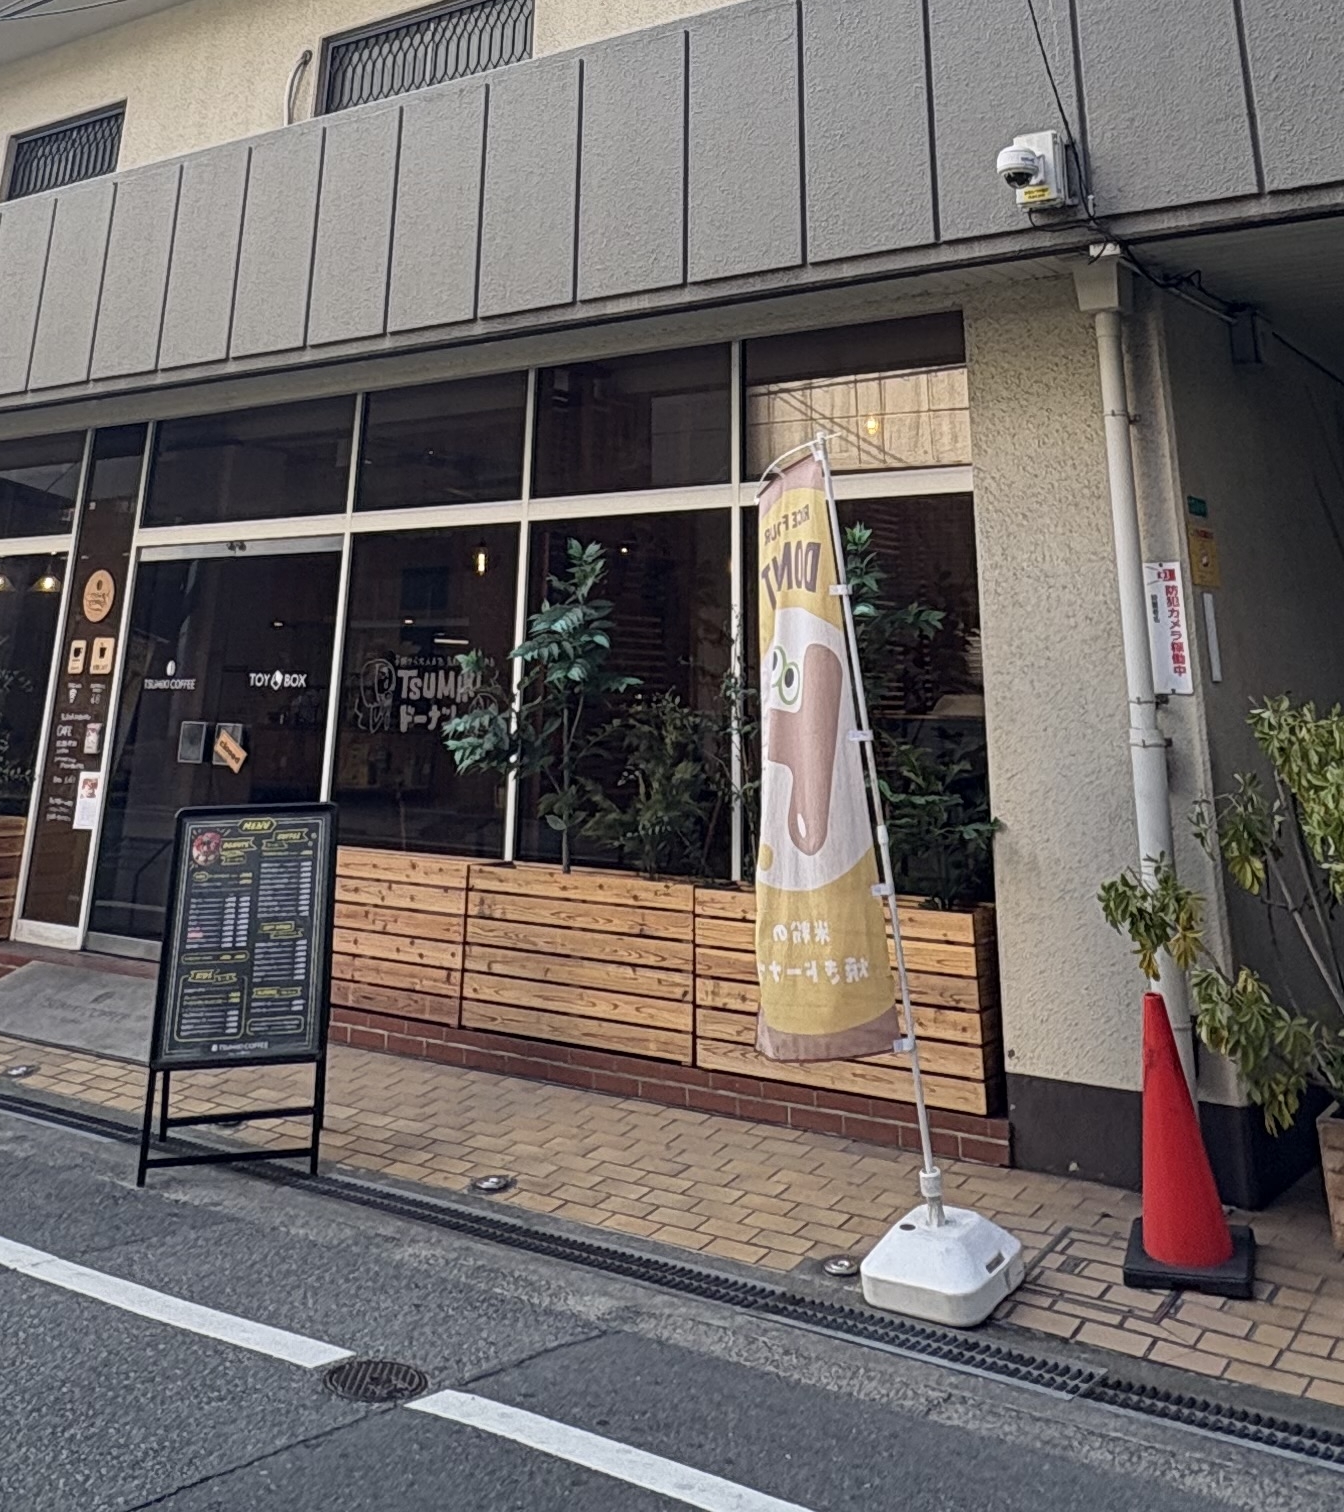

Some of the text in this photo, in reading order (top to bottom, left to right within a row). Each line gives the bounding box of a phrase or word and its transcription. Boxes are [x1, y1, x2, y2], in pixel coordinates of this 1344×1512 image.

[170, 678, 196, 691] COFFEE
[249, 673, 307, 688] TOY BOX
[242, 821, 272, 830] MENU
